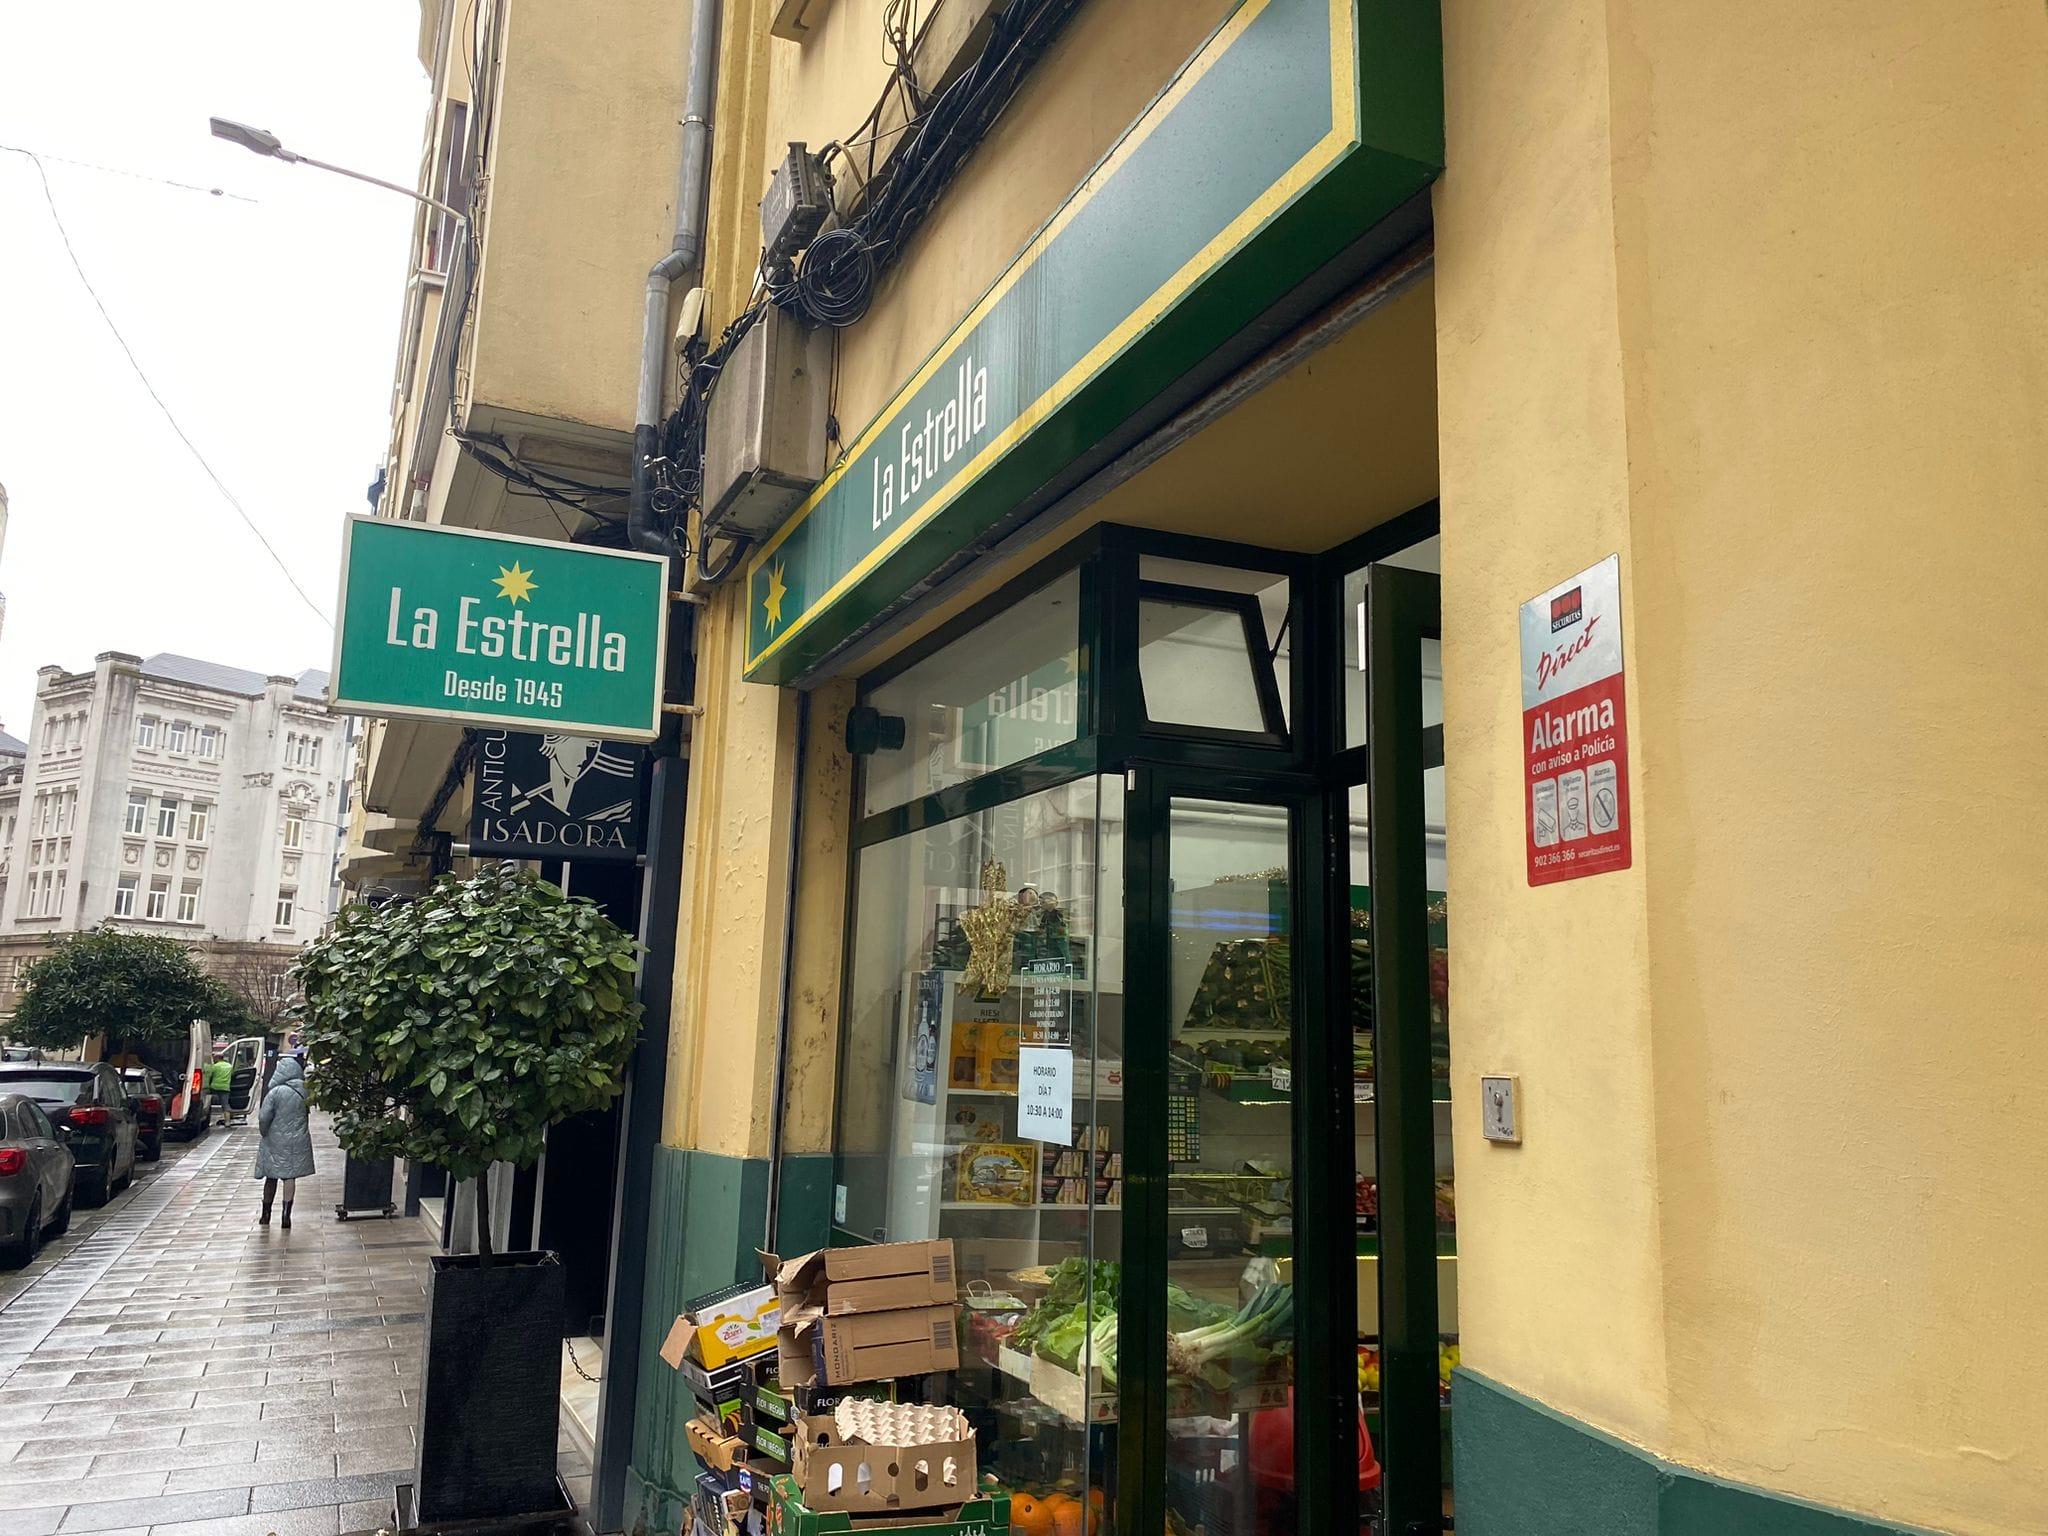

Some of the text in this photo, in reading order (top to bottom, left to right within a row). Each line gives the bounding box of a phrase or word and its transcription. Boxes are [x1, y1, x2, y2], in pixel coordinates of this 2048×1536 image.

[872, 356, 987, 532] La Estrella
[386, 586, 627, 673] La Estrella
[1552, 610, 1582, 631] SECURITAS
[1536, 615, 1602, 691] Direct
[444, 670, 564, 709] Desde 1945
[1531, 698, 1615, 754] Alarma
[1532, 735, 1615, 775] con aviso a Policía
[482, 818, 627, 850] ISADORA
[1534, 855, 1547, 868] 902
[1548, 852, 1561, 865] 366
[1562, 848, 1576, 862] 366
[1033, 962, 1060, 974] HORARIO
[1033, 1066, 1056, 1077] HORARIO
[1038, 1083, 1052, 1096] DÍA 7
[1027, 1104, 1063, 1119] 10:30 A 14:00
[831, 1322, 841, 1378] MONDARIZ
